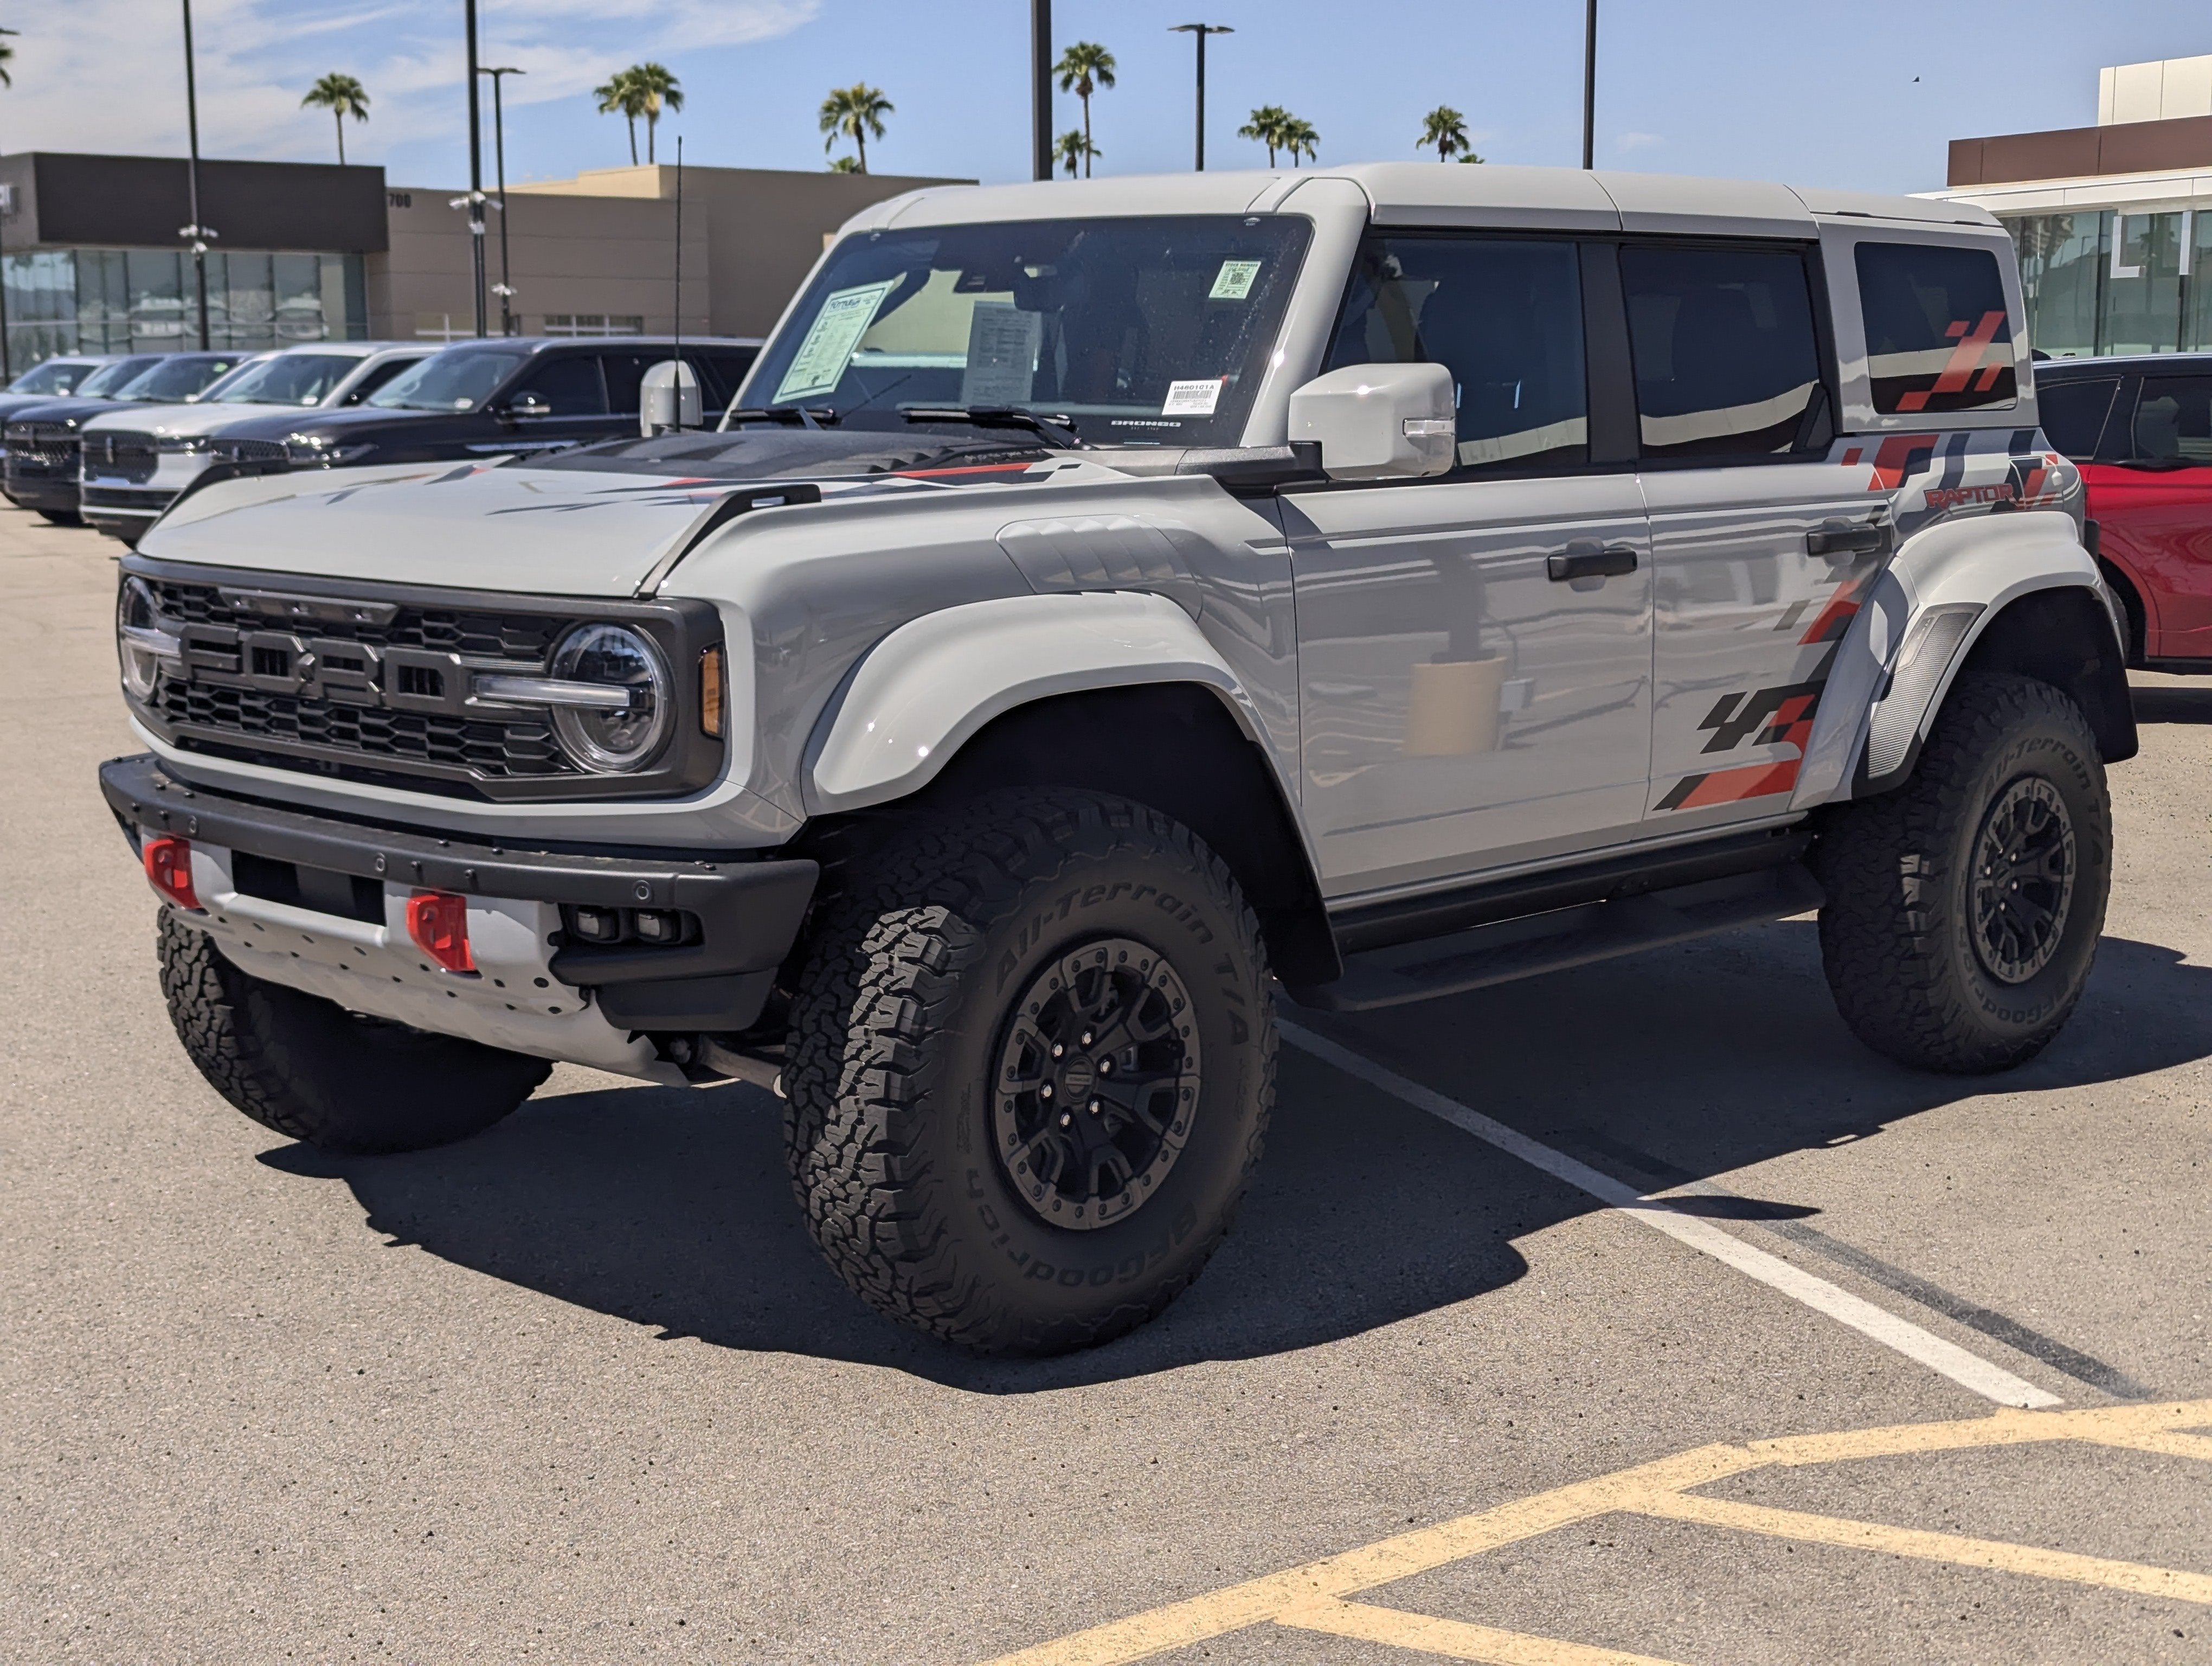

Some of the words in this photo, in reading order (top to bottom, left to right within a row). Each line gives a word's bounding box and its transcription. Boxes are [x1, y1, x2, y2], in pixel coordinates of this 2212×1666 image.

[1924, 483, 2014, 509] RAPTOR
[179, 624, 462, 714] FORD
[996, 881, 1214, 996] All-Terrain
[1213, 952, 1249, 1046] T/A
[967, 1169, 1199, 1288] BFGoodrich
